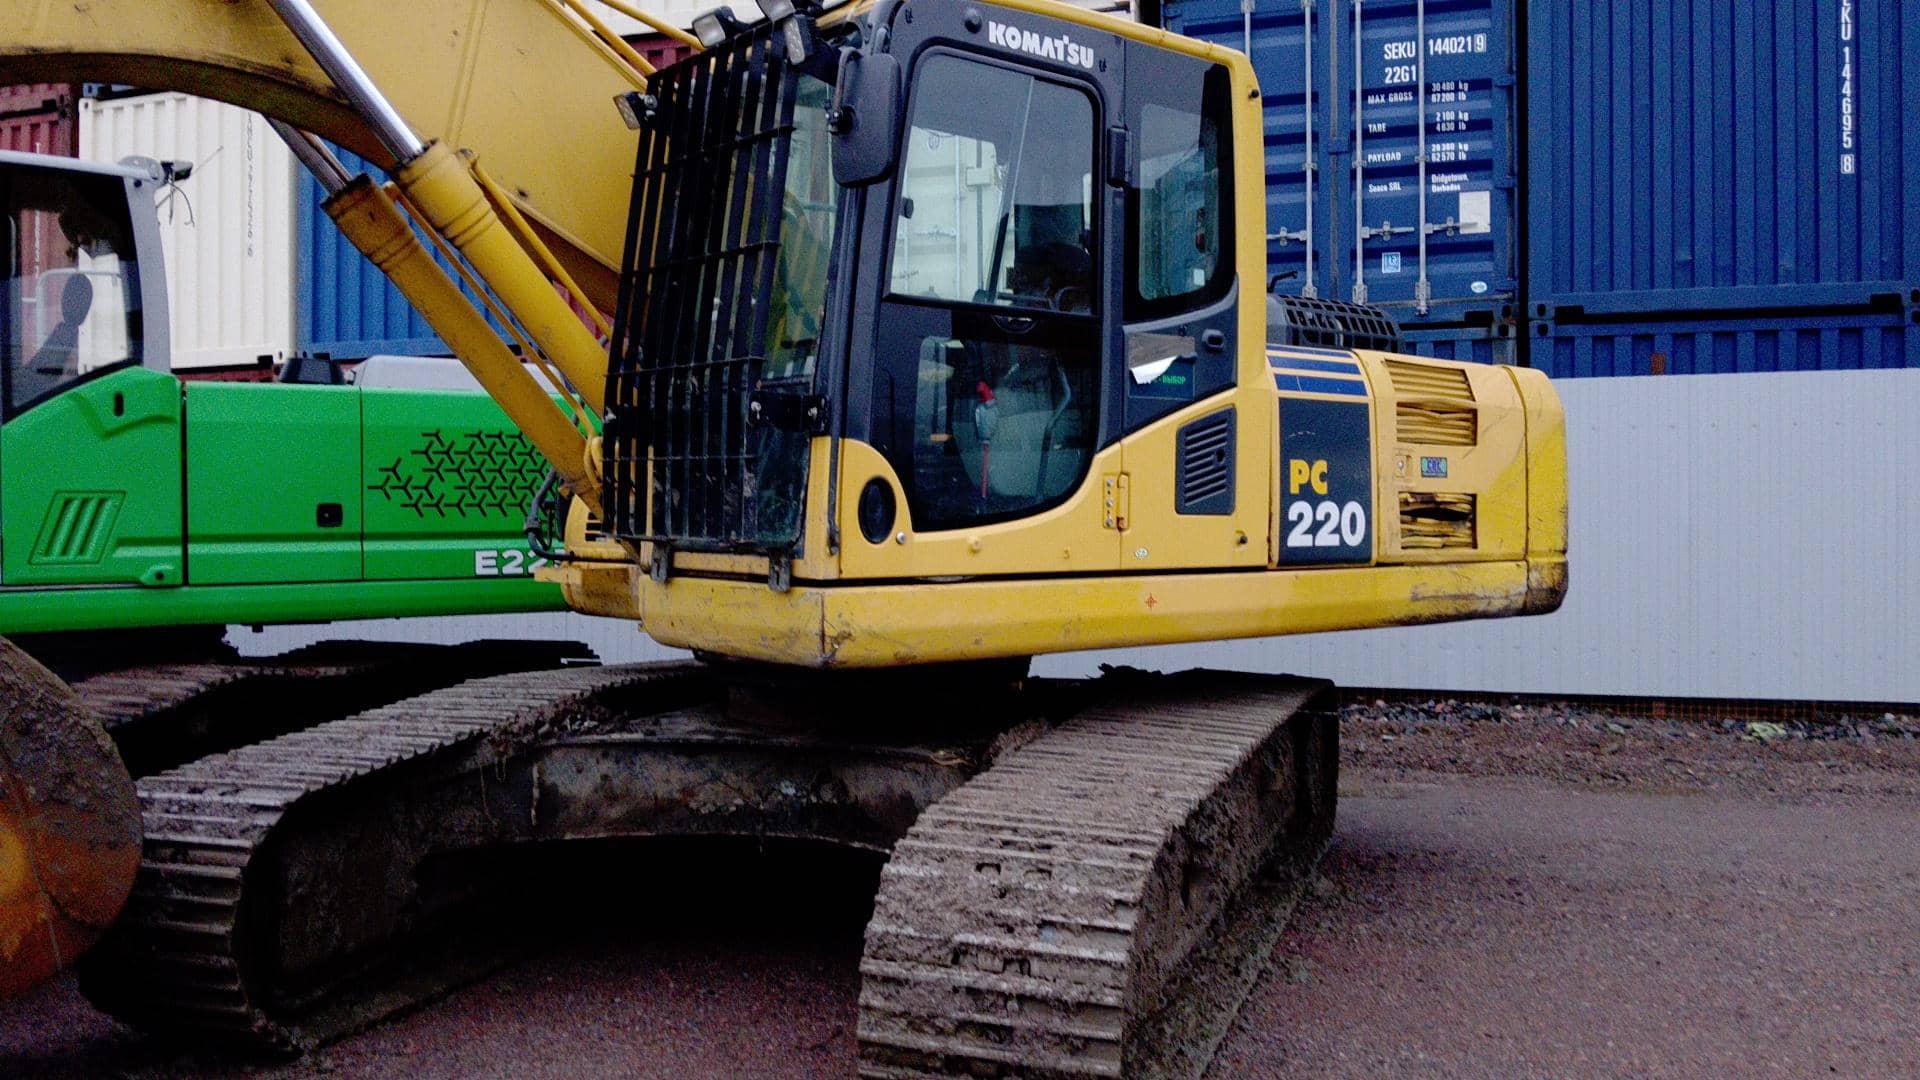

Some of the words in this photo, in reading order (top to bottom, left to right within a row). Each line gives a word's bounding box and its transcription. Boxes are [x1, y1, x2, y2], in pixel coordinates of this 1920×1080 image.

[1841, 0, 1851, 40] KU
[988, 21, 1094, 68] KOMATSU
[1384, 41, 1416, 60] SEKU
[1384, 65, 1416, 84] 22G1
[1367, 94, 1386, 105] MAX
[1388, 92, 1414, 103] GROSS
[1841, 46, 1852, 149] 144695
[1368, 123, 1387, 133] TARE
[1367, 152, 1402, 163] PAYLOAD
[1841, 154, 1854, 174] 8
[1289, 459, 1328, 495] PC
[1286, 500, 1366, 547] 220
